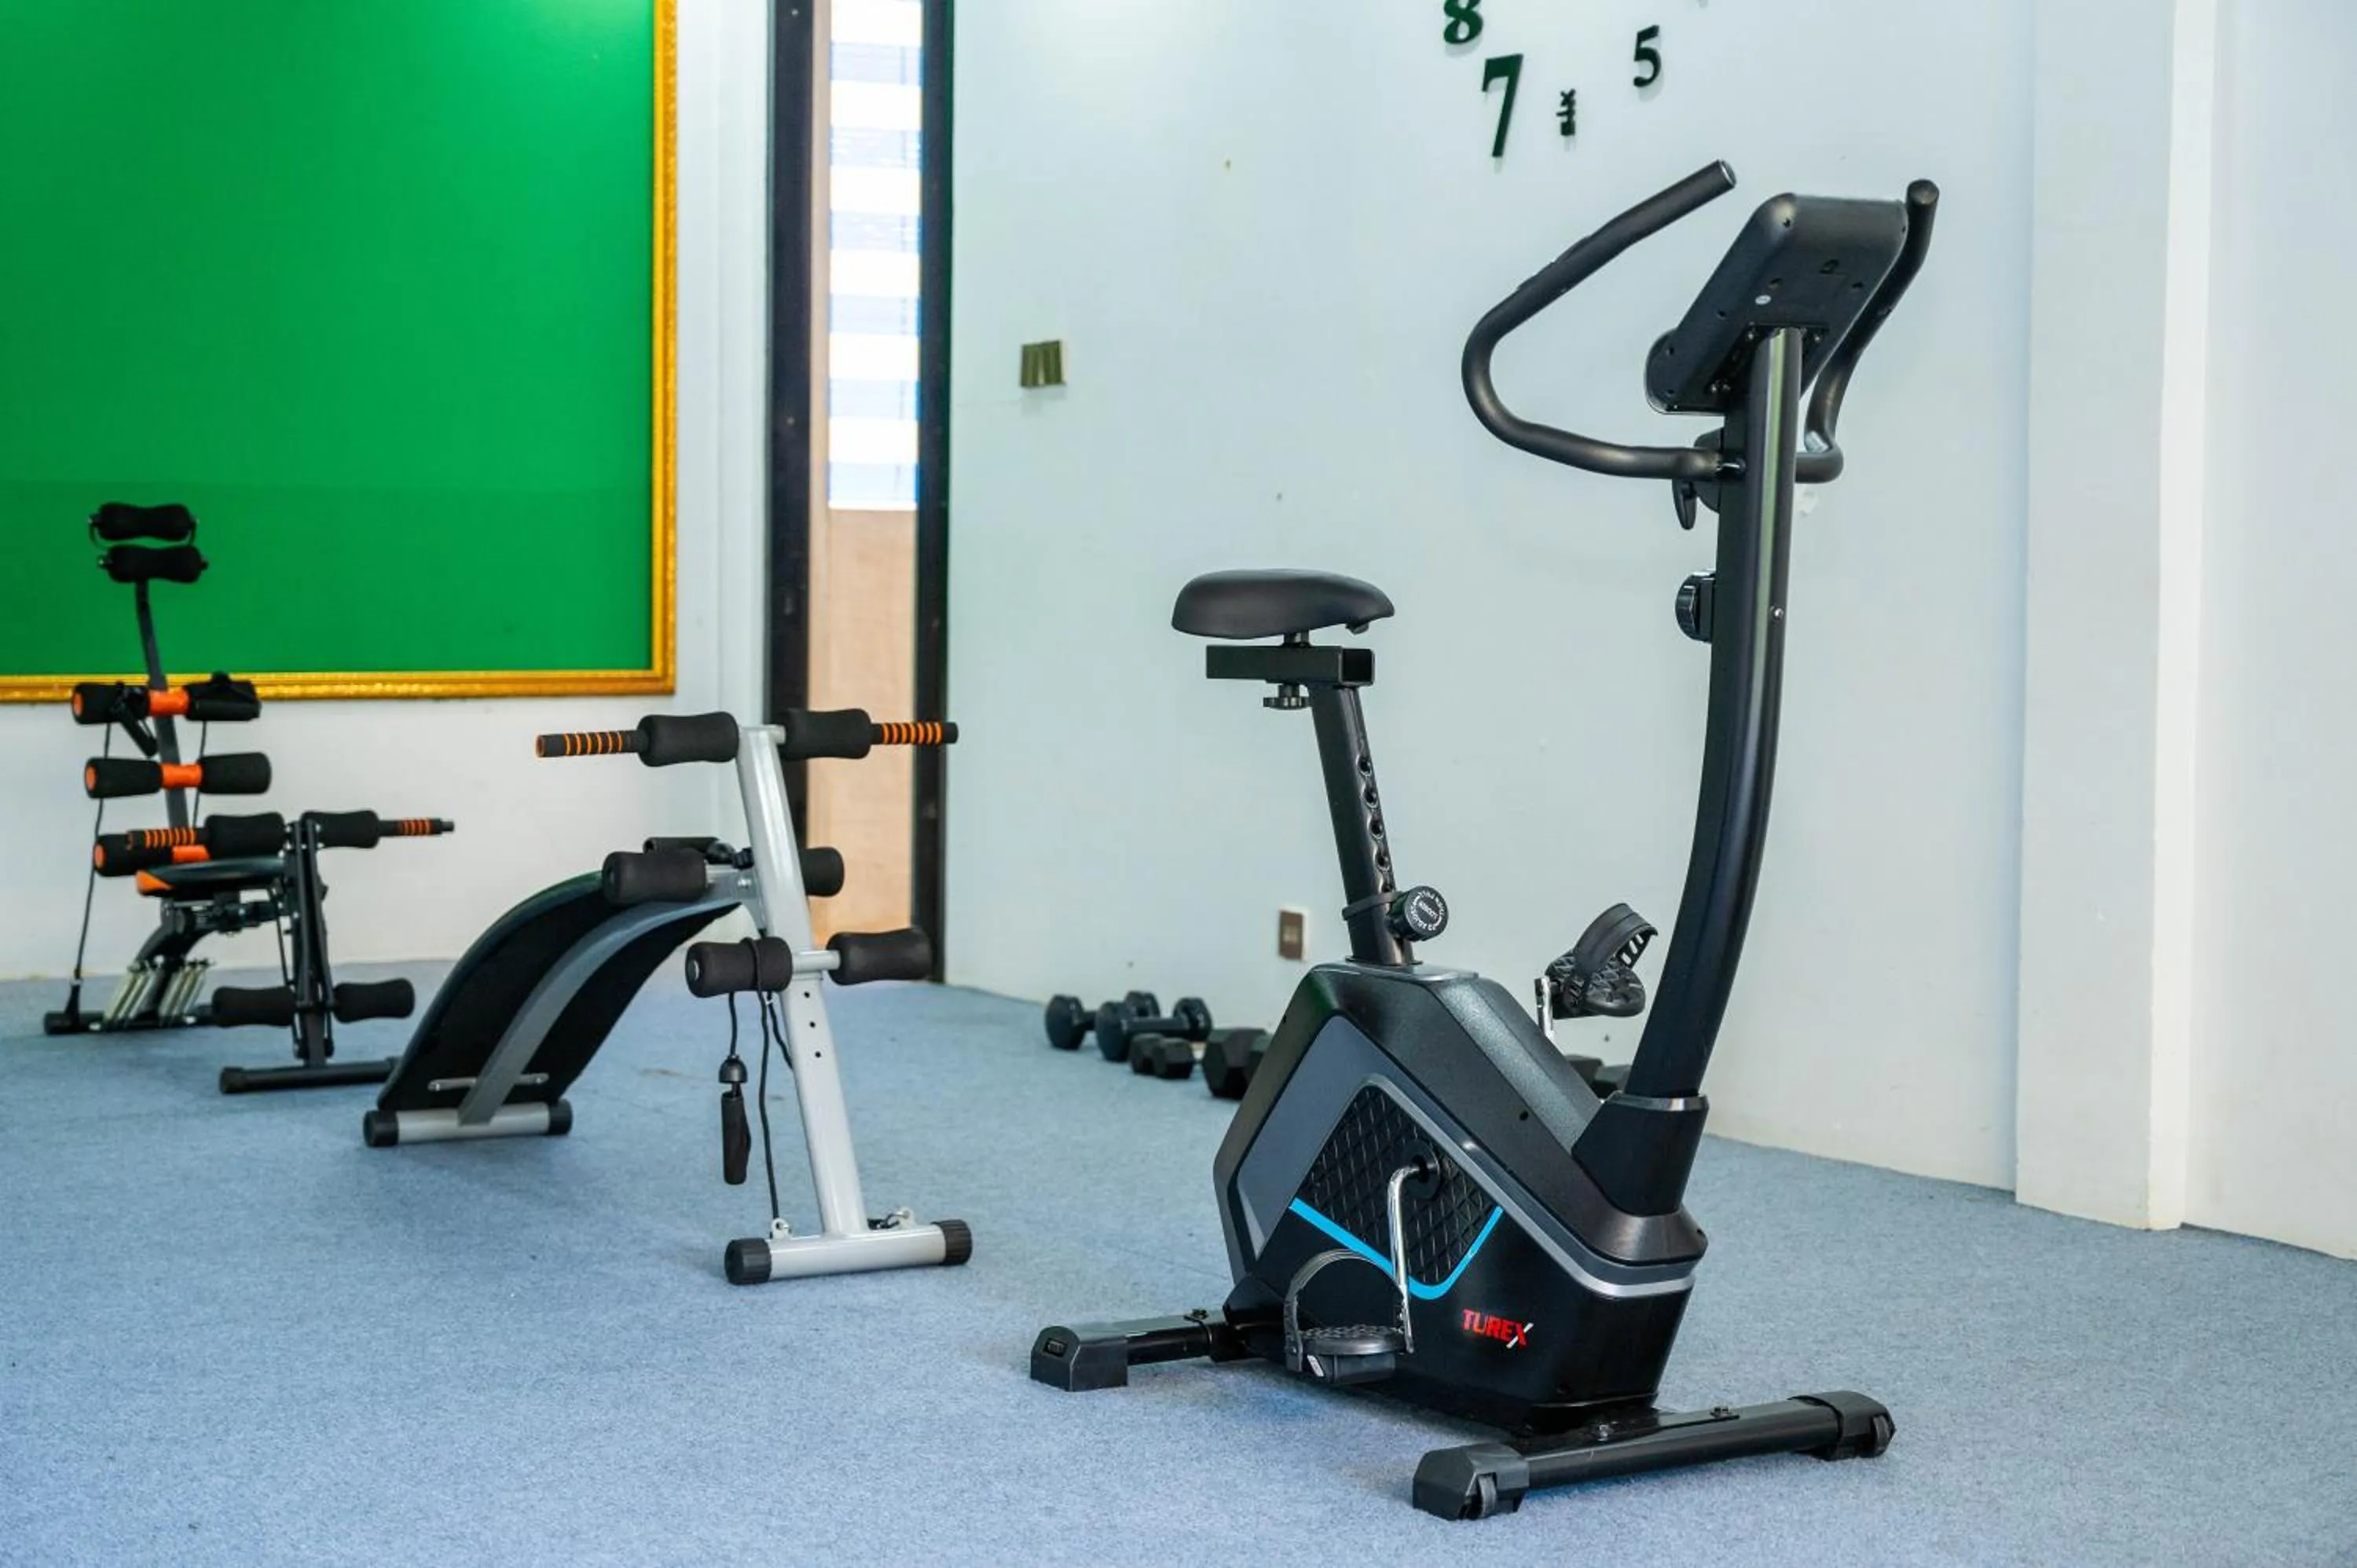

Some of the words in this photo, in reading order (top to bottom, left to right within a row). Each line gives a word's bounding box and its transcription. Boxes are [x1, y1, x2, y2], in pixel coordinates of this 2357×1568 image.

[1443, 0, 1484, 44] 8
[1633, 24, 1662, 88] 5
[1482, 53, 1523, 158] 7
[1462, 1308, 1534, 1349] TUREX
